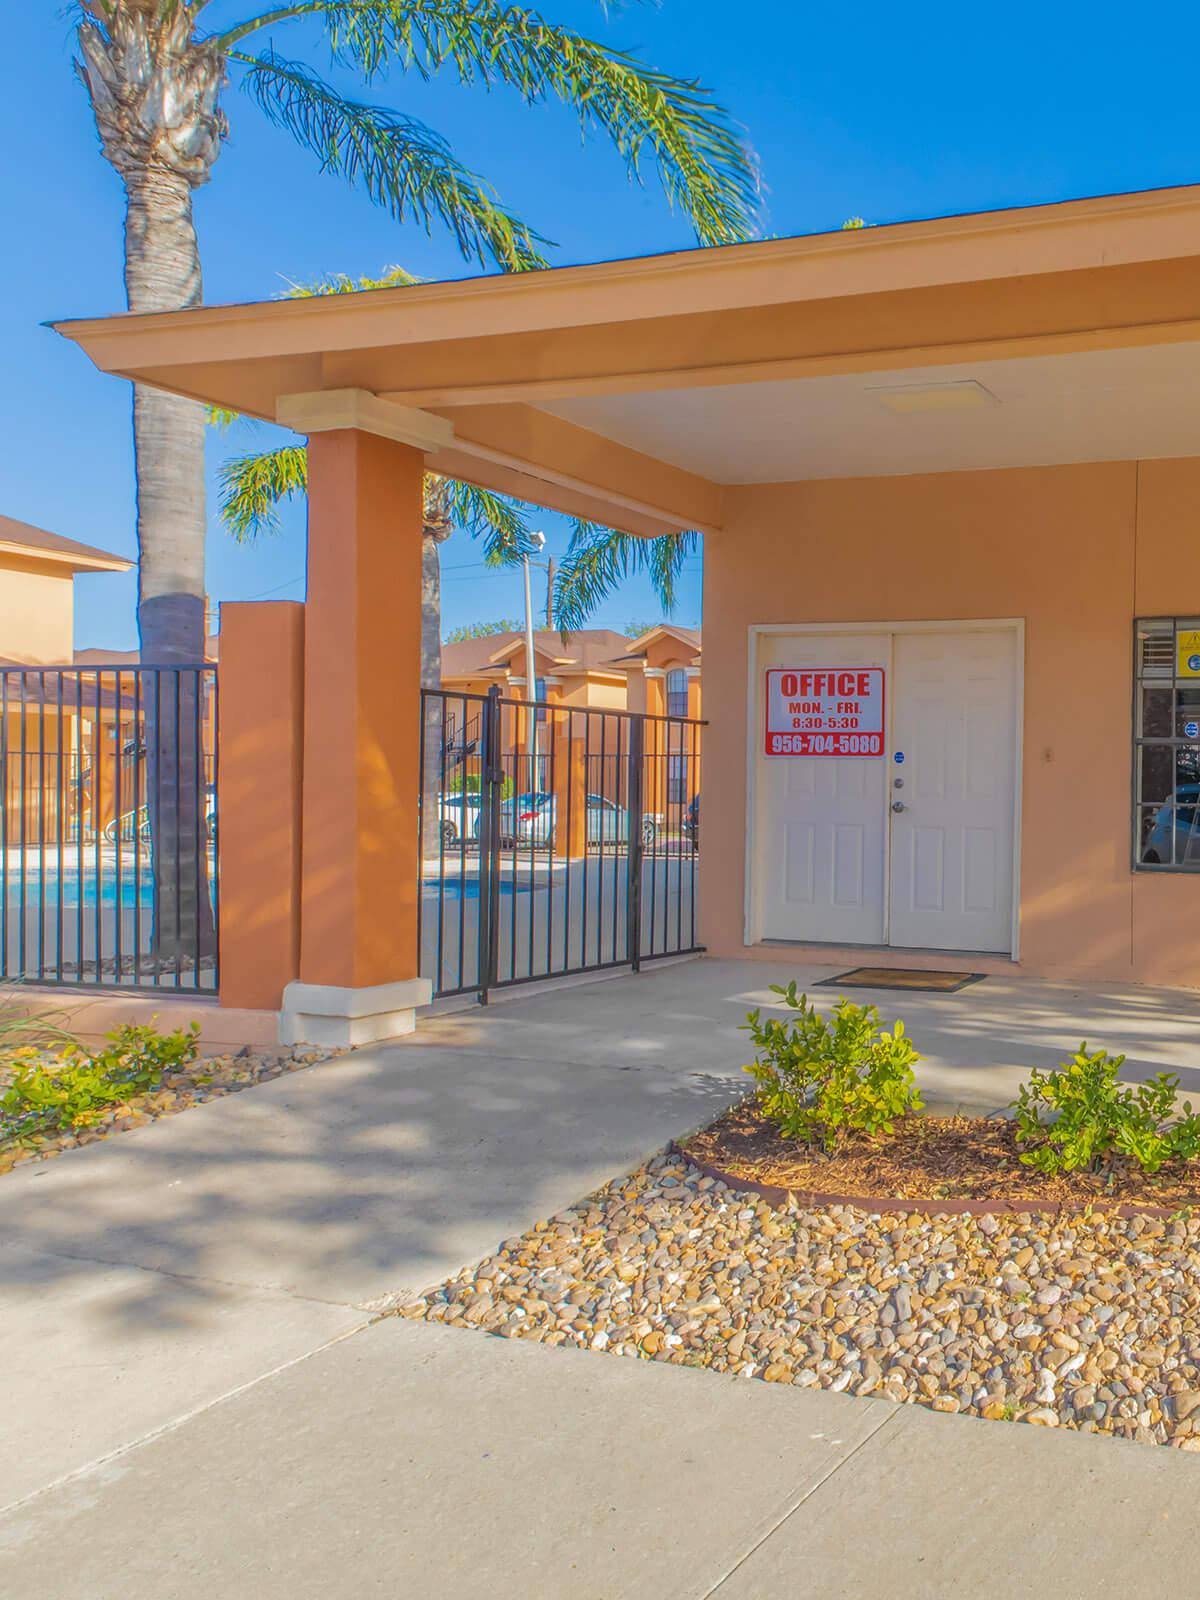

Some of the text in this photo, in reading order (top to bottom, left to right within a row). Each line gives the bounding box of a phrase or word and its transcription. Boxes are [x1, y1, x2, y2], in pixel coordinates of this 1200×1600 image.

[781, 673, 870, 697] OFFICE
[789, 702, 824, 714] MON.
[837, 702, 862, 714] FRI.
[792, 717, 858, 729] 8:30-5:30
[772, 735, 880, 753] 956-704-5080
